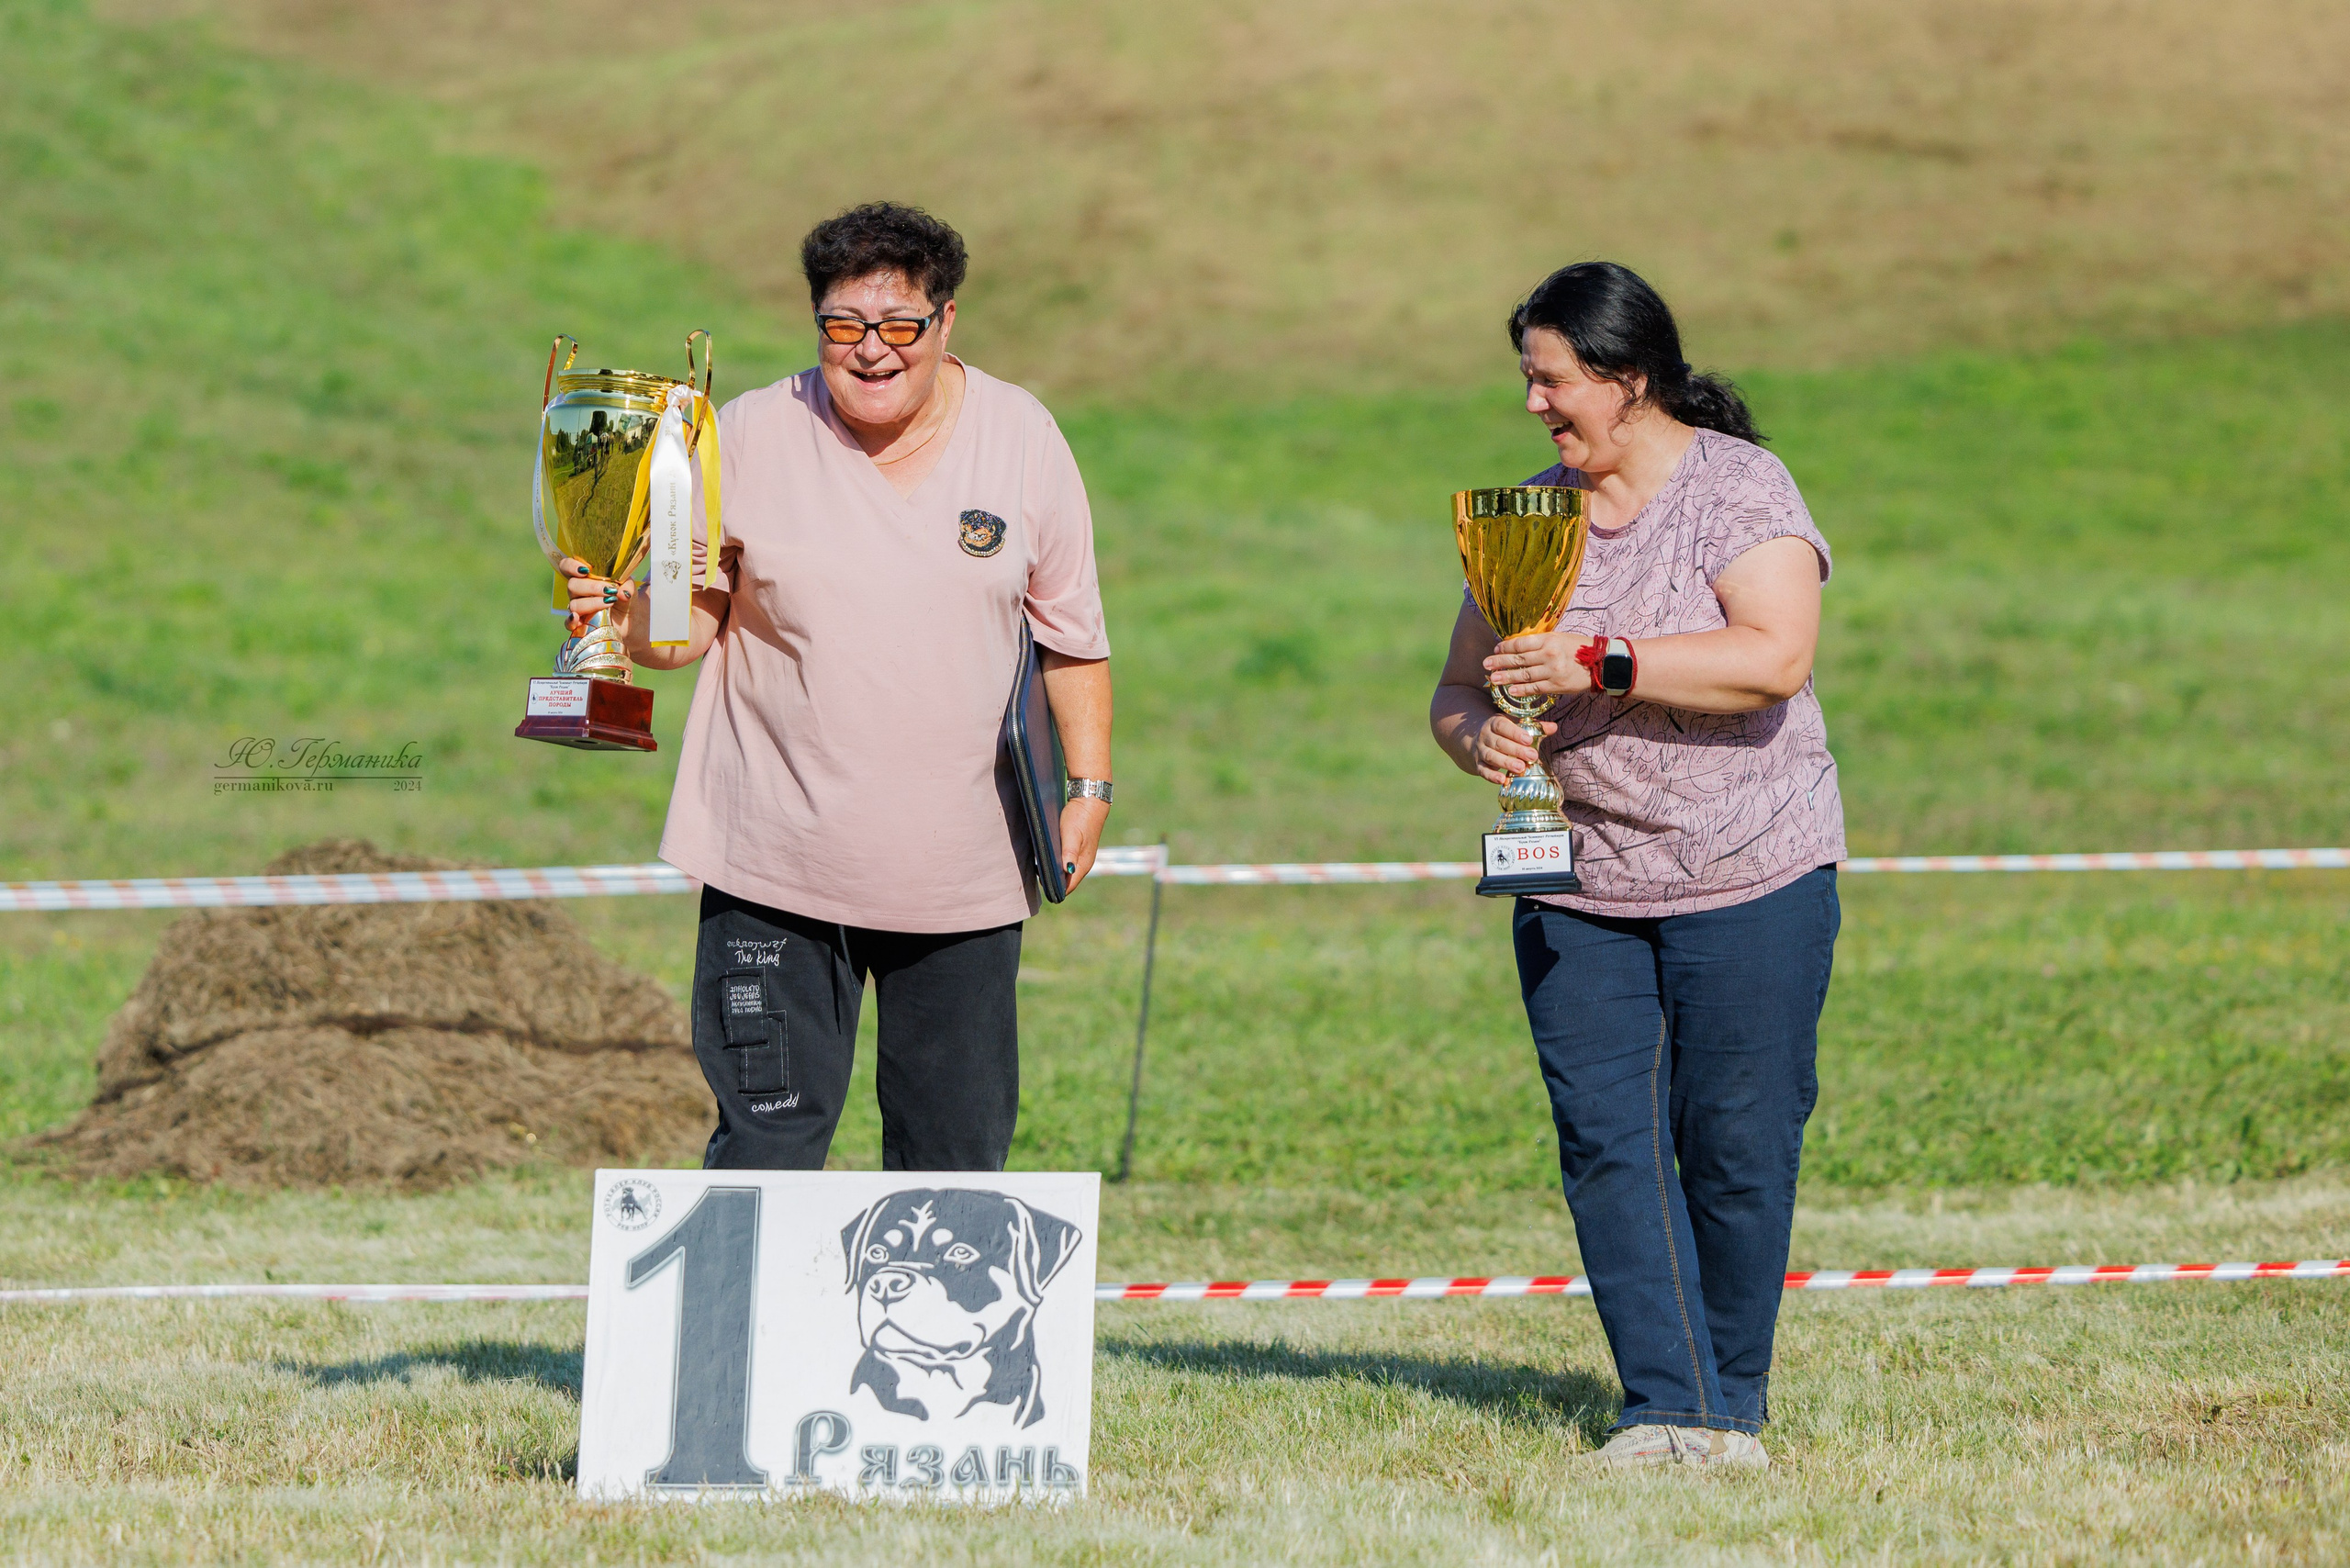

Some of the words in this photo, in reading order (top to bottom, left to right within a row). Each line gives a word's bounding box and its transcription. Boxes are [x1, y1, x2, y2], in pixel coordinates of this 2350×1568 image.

[734, 949, 754, 965] The
[632, 1180, 652, 1189] КЛУБ
[626, 1185, 769, 1488] 1
